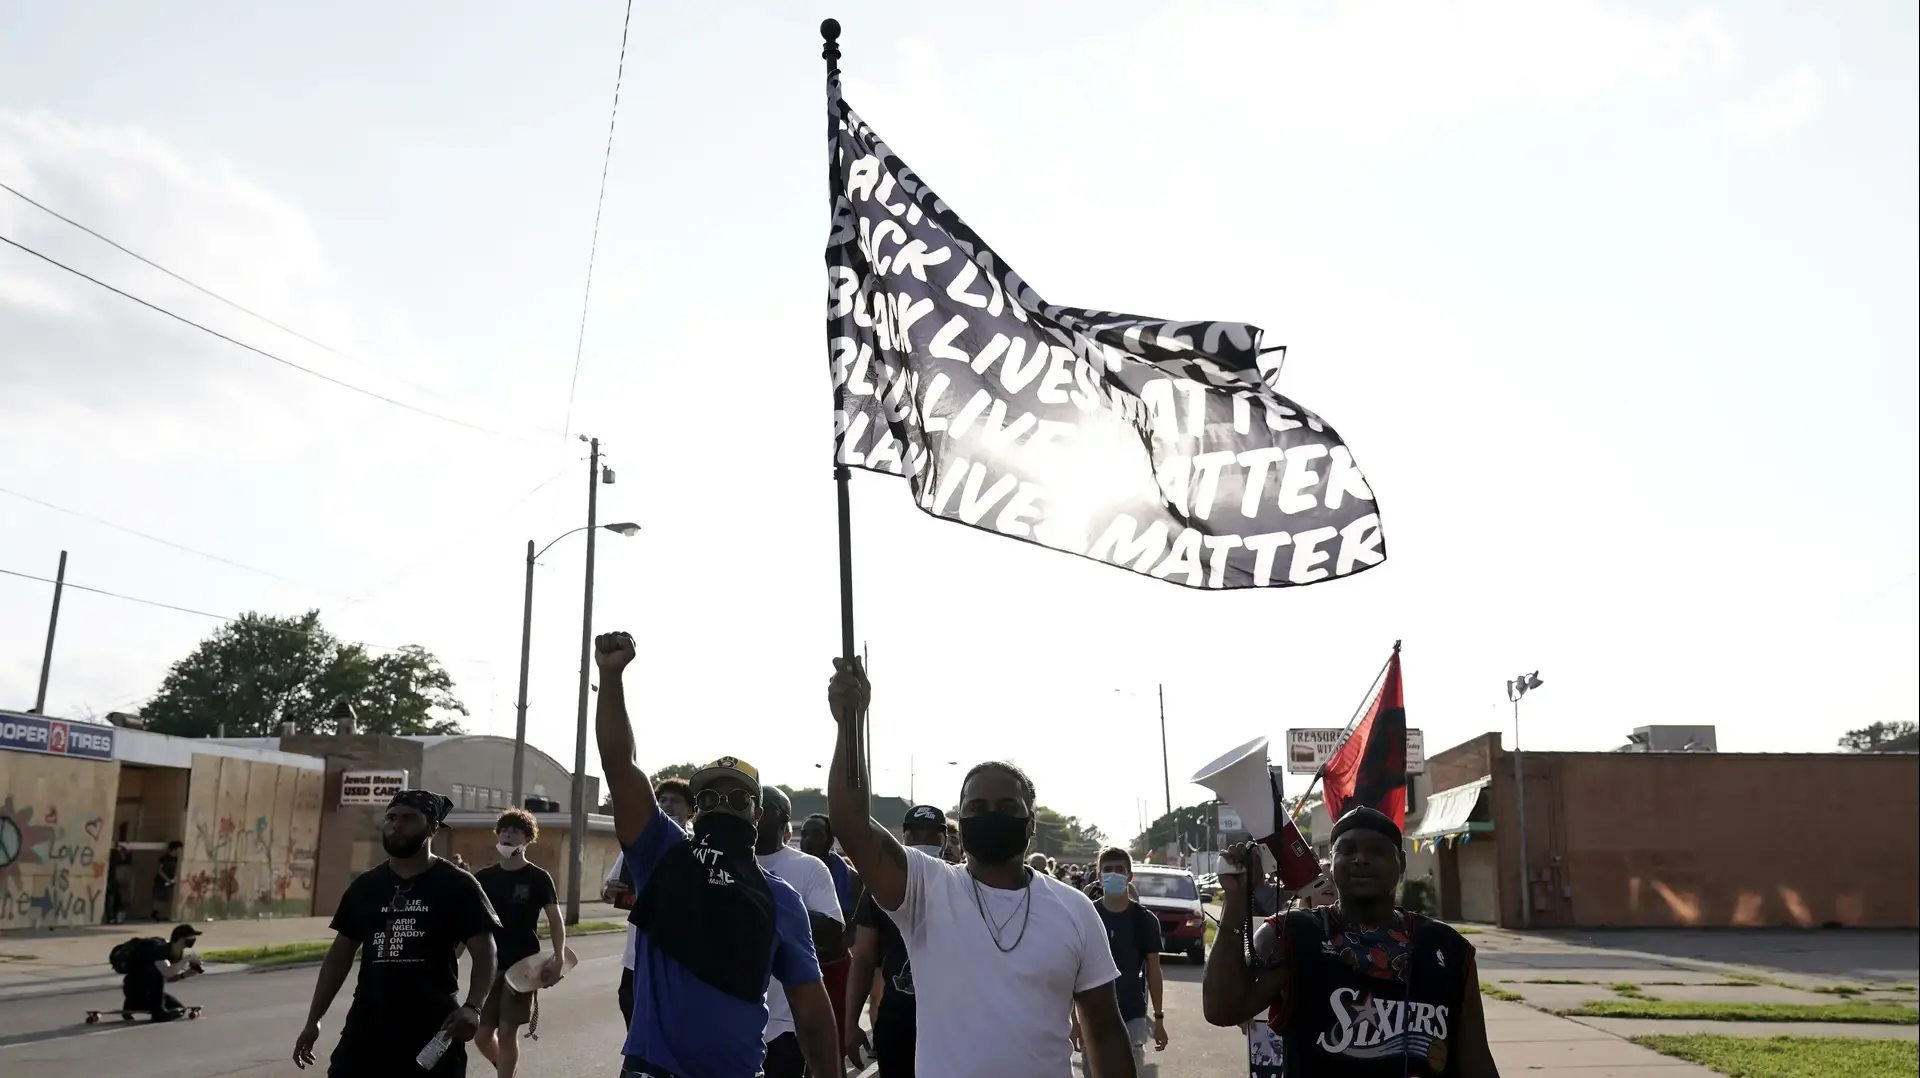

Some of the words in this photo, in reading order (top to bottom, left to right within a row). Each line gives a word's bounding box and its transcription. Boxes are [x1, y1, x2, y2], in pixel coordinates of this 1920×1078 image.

[928, 315, 1108, 412] LIVES
[1082, 512, 1386, 588] MATTER
[0, 722, 48, 743] OPER
[70, 731, 111, 752] TIRES
[344, 786, 371, 796] USED
[373, 786, 401, 796] CARS
[393, 930, 425, 938] DADDY
